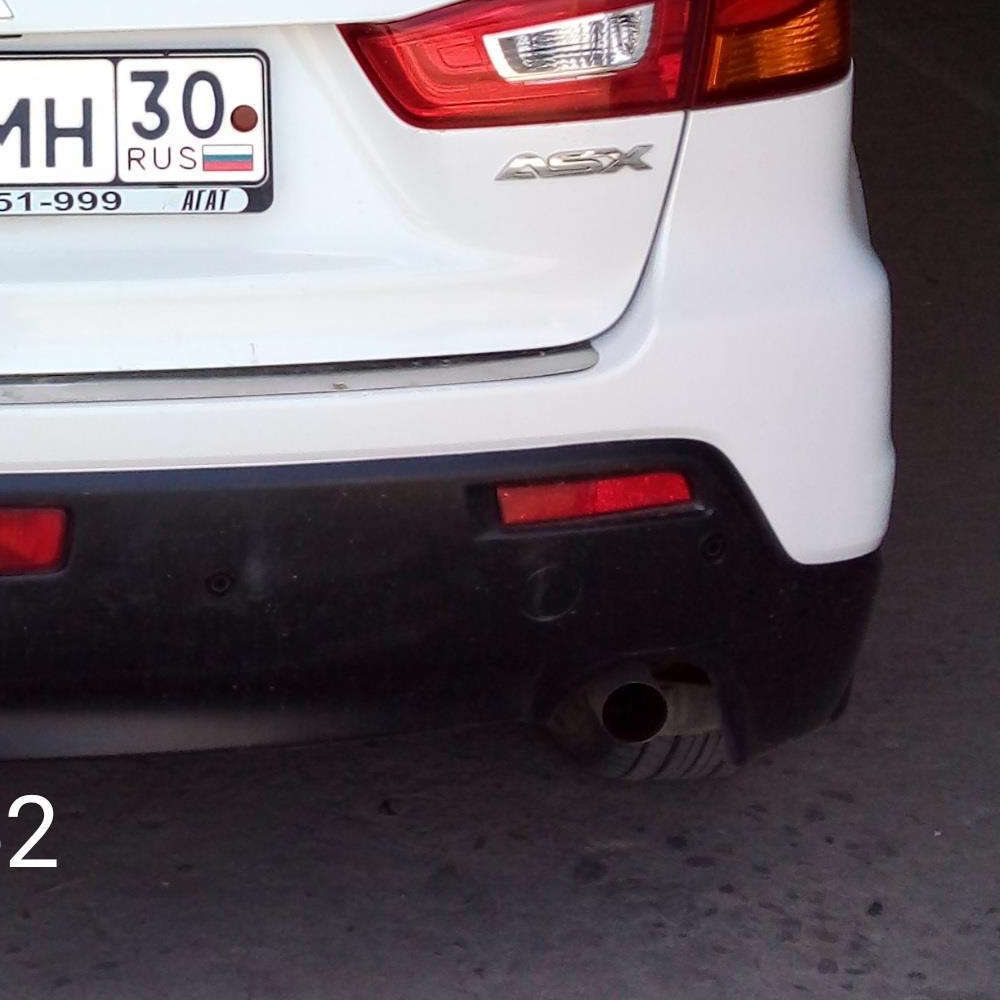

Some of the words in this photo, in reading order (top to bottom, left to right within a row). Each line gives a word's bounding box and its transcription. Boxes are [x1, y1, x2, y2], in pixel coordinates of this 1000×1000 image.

[130, 70, 225, 141] 30
[127, 146, 197, 171] RUS
[495, 144, 653, 181] ASX
